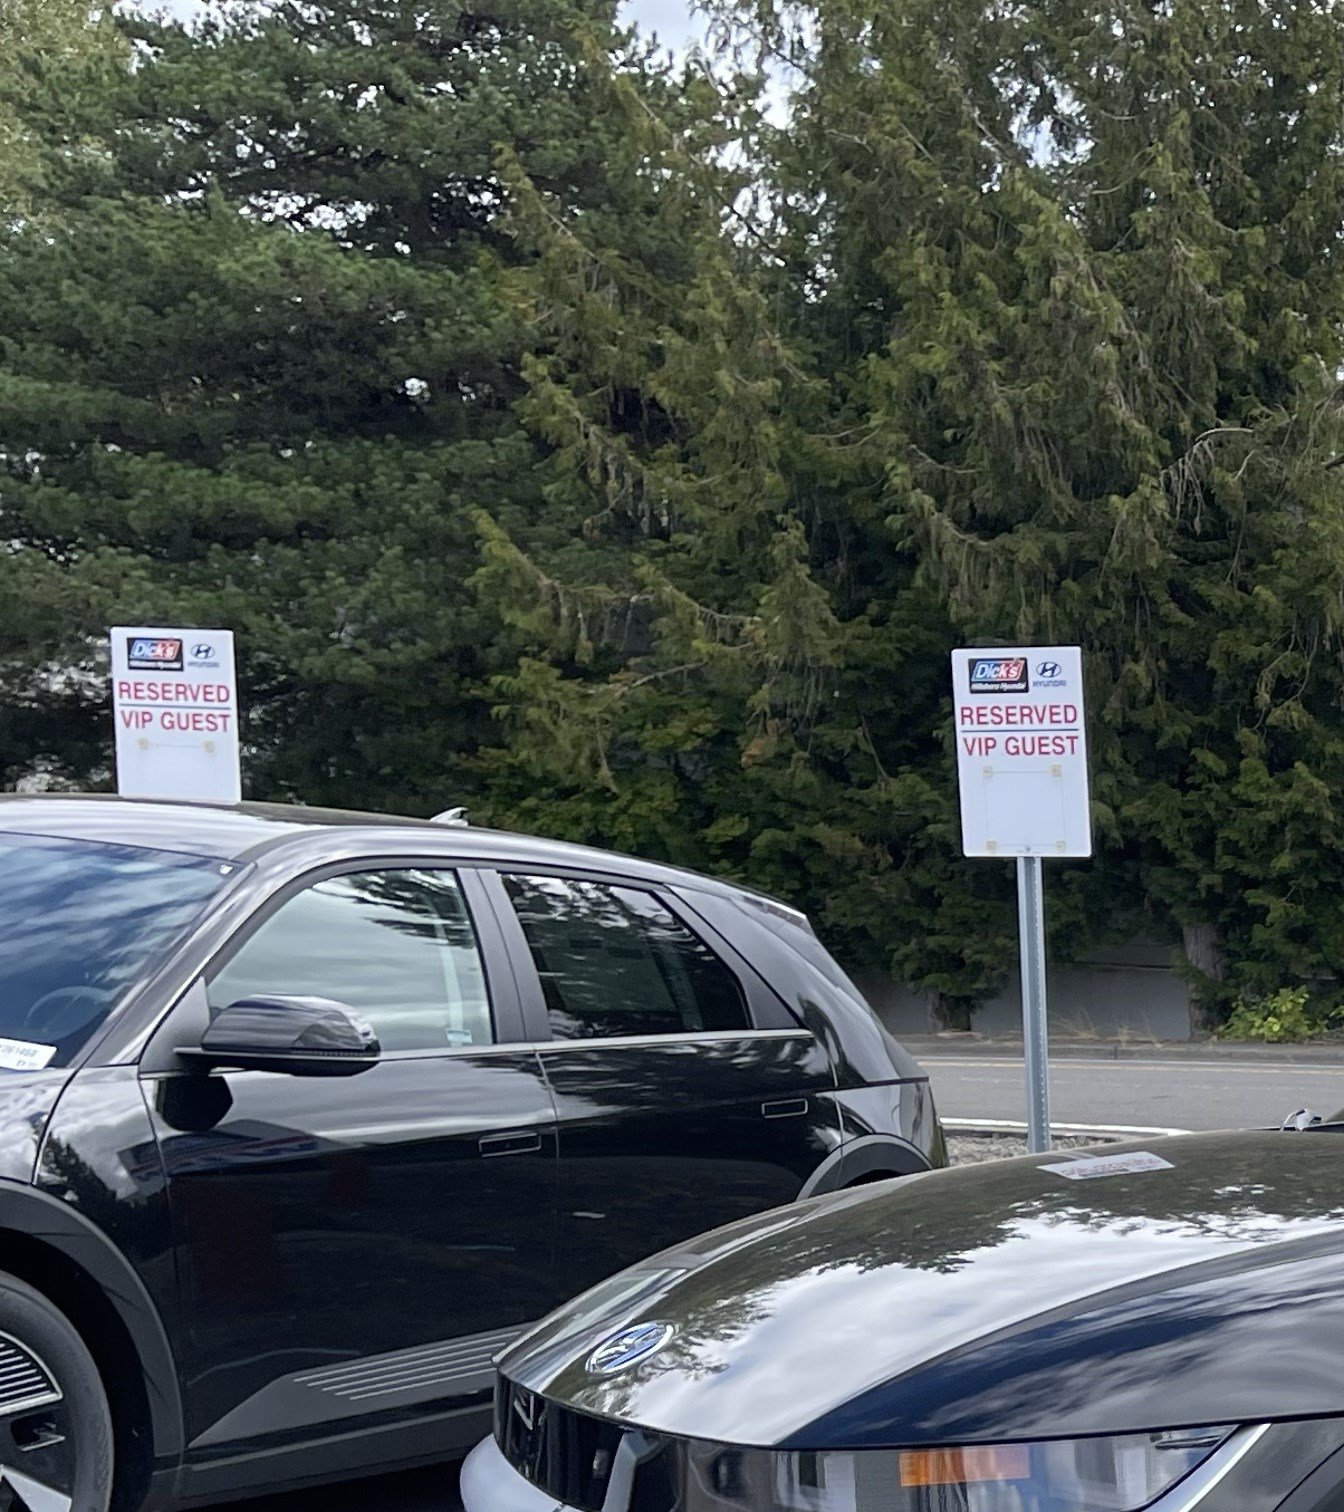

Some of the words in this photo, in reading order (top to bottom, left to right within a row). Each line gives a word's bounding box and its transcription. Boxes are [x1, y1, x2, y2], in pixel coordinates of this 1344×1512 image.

[118, 681, 230, 703] RESERVED
[121, 710, 153, 729] VIP
[160, 711, 231, 732] GUEST
[960, 704, 1078, 725] RESERVED
[963, 737, 997, 756] VIP
[1005, 735, 1079, 755] GUEST
